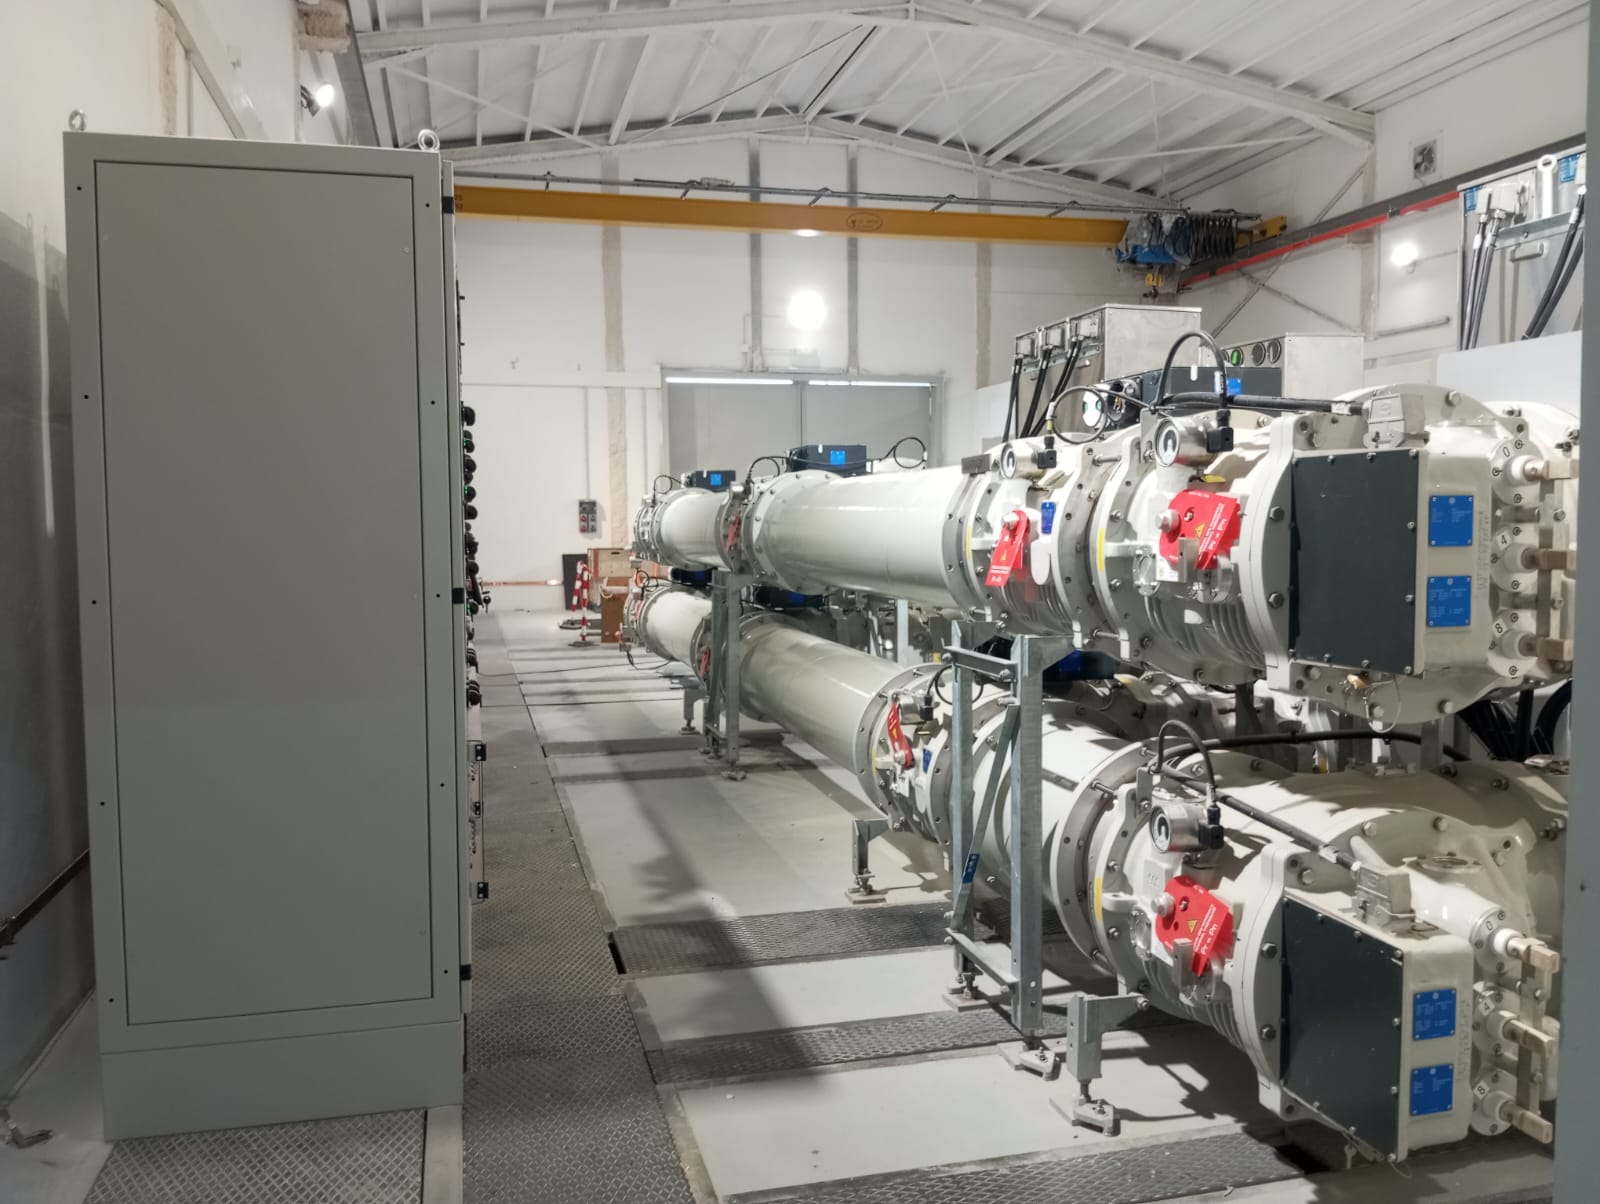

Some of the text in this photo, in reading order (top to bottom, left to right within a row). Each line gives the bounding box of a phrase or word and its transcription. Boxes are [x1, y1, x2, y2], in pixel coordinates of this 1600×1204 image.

[1501, 534, 1508, 545] 4
[1494, 623, 1503, 634] 8
[1477, 1085, 1486, 1095] 8
